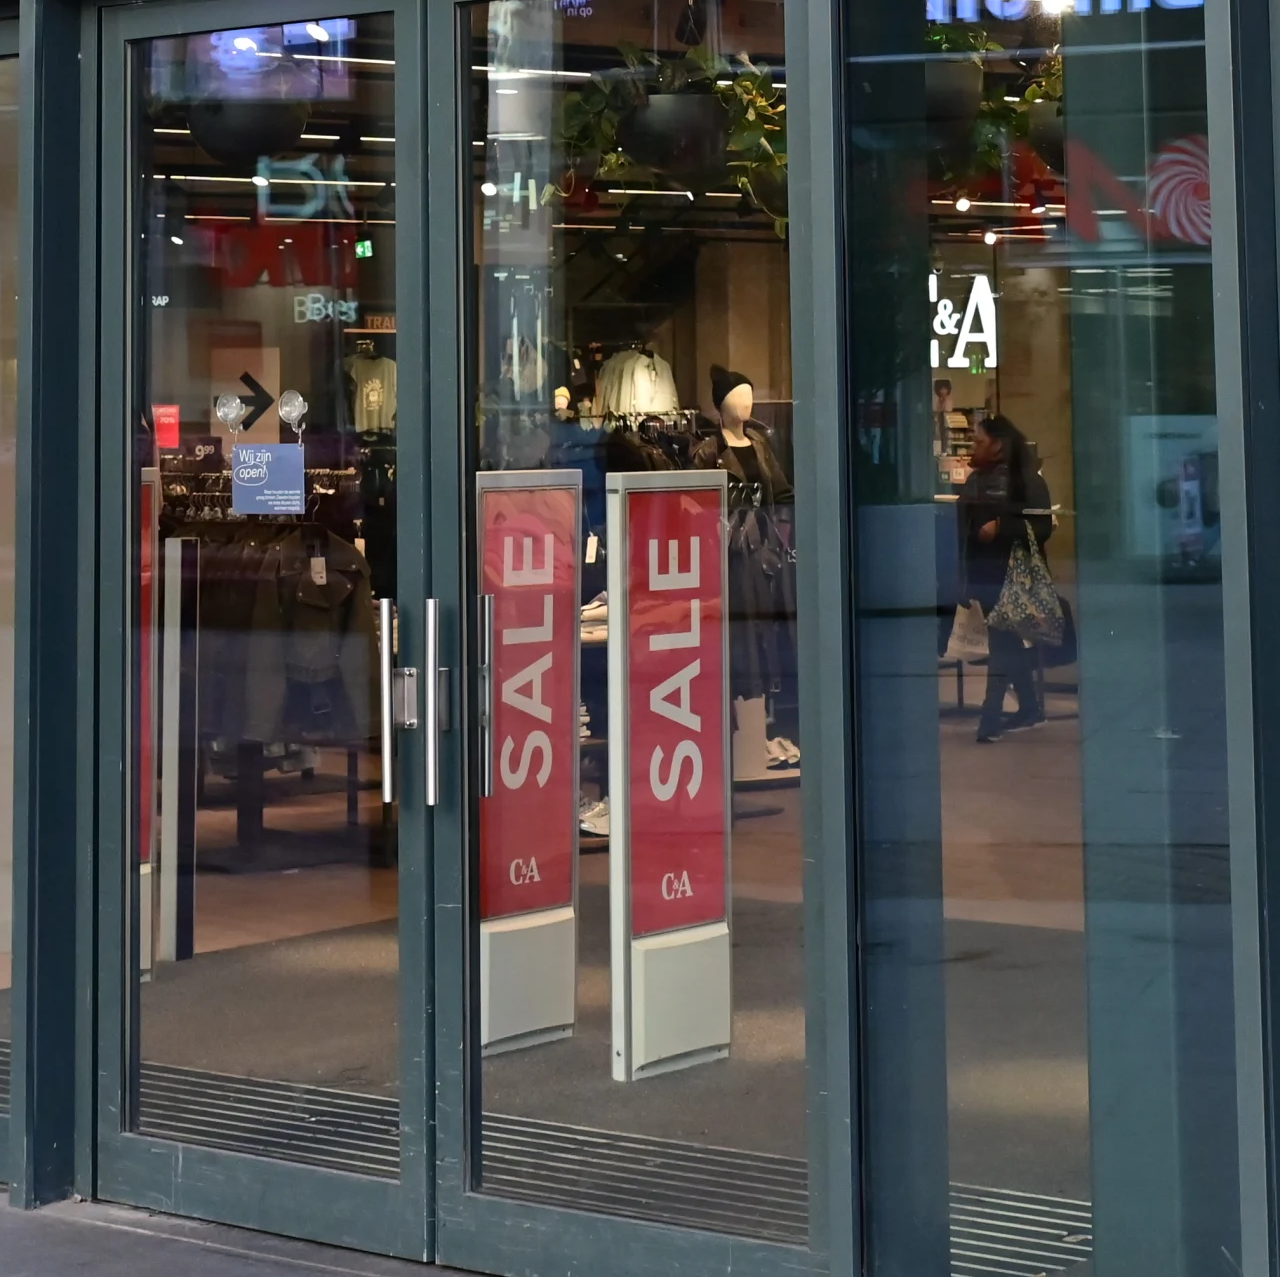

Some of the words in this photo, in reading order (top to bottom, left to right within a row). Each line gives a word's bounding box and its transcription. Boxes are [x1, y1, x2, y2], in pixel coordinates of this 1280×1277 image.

[929, 274, 998, 369] &A
[239, 449, 255, 465] Wij
[255, 449, 272, 465] zijn
[239, 465, 267, 481] open!
[500, 533, 555, 790] SALE
[649, 536, 702, 800] SALE
[509, 856, 542, 887] C&A
[661, 870, 694, 901] C&A
